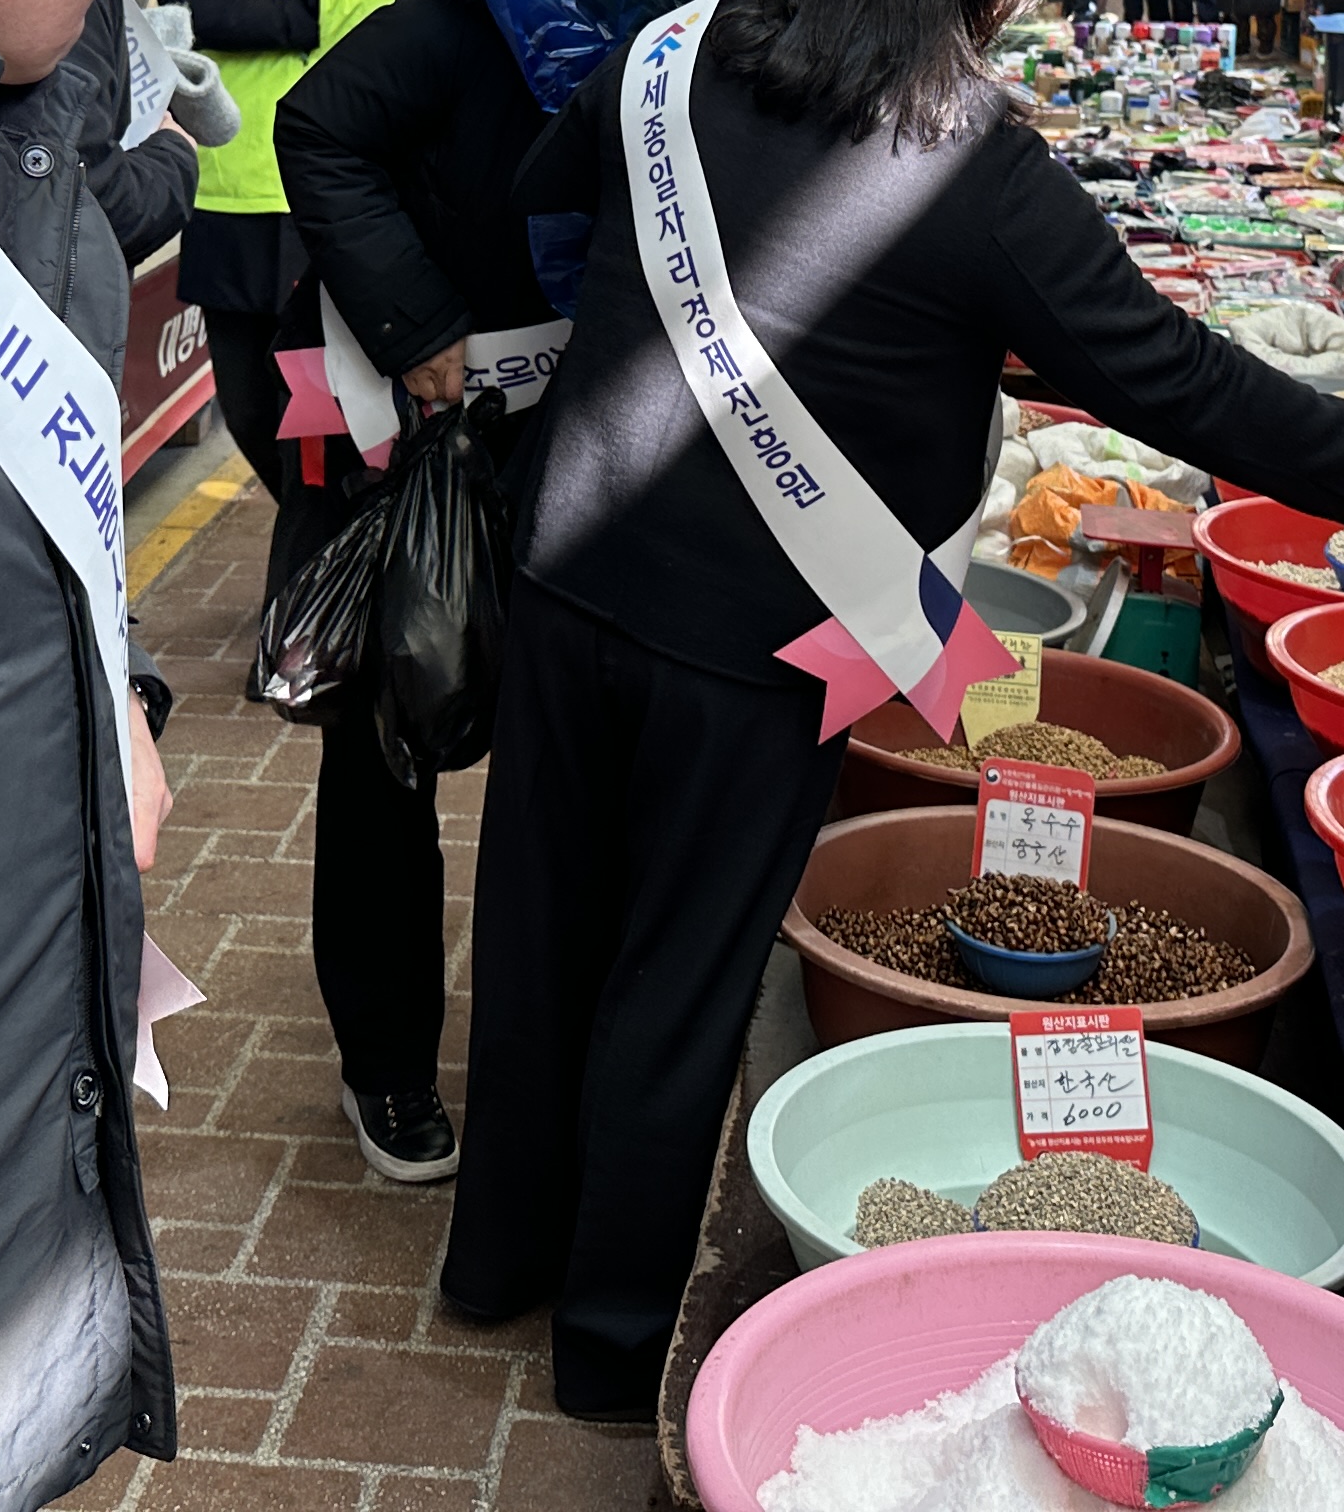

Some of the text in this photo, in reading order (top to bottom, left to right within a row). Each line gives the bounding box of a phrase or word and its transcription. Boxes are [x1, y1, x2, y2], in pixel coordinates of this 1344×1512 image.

[640, 70, 827, 511] 세종일자리경제진흥원
[1009, 789, 1065, 808] 원산지표시판
[1021, 807, 1081, 839] 옥수수
[1042, 1014, 1110, 1031] 원산지표시판
[1063, 1101, 1122, 1126] 6000
